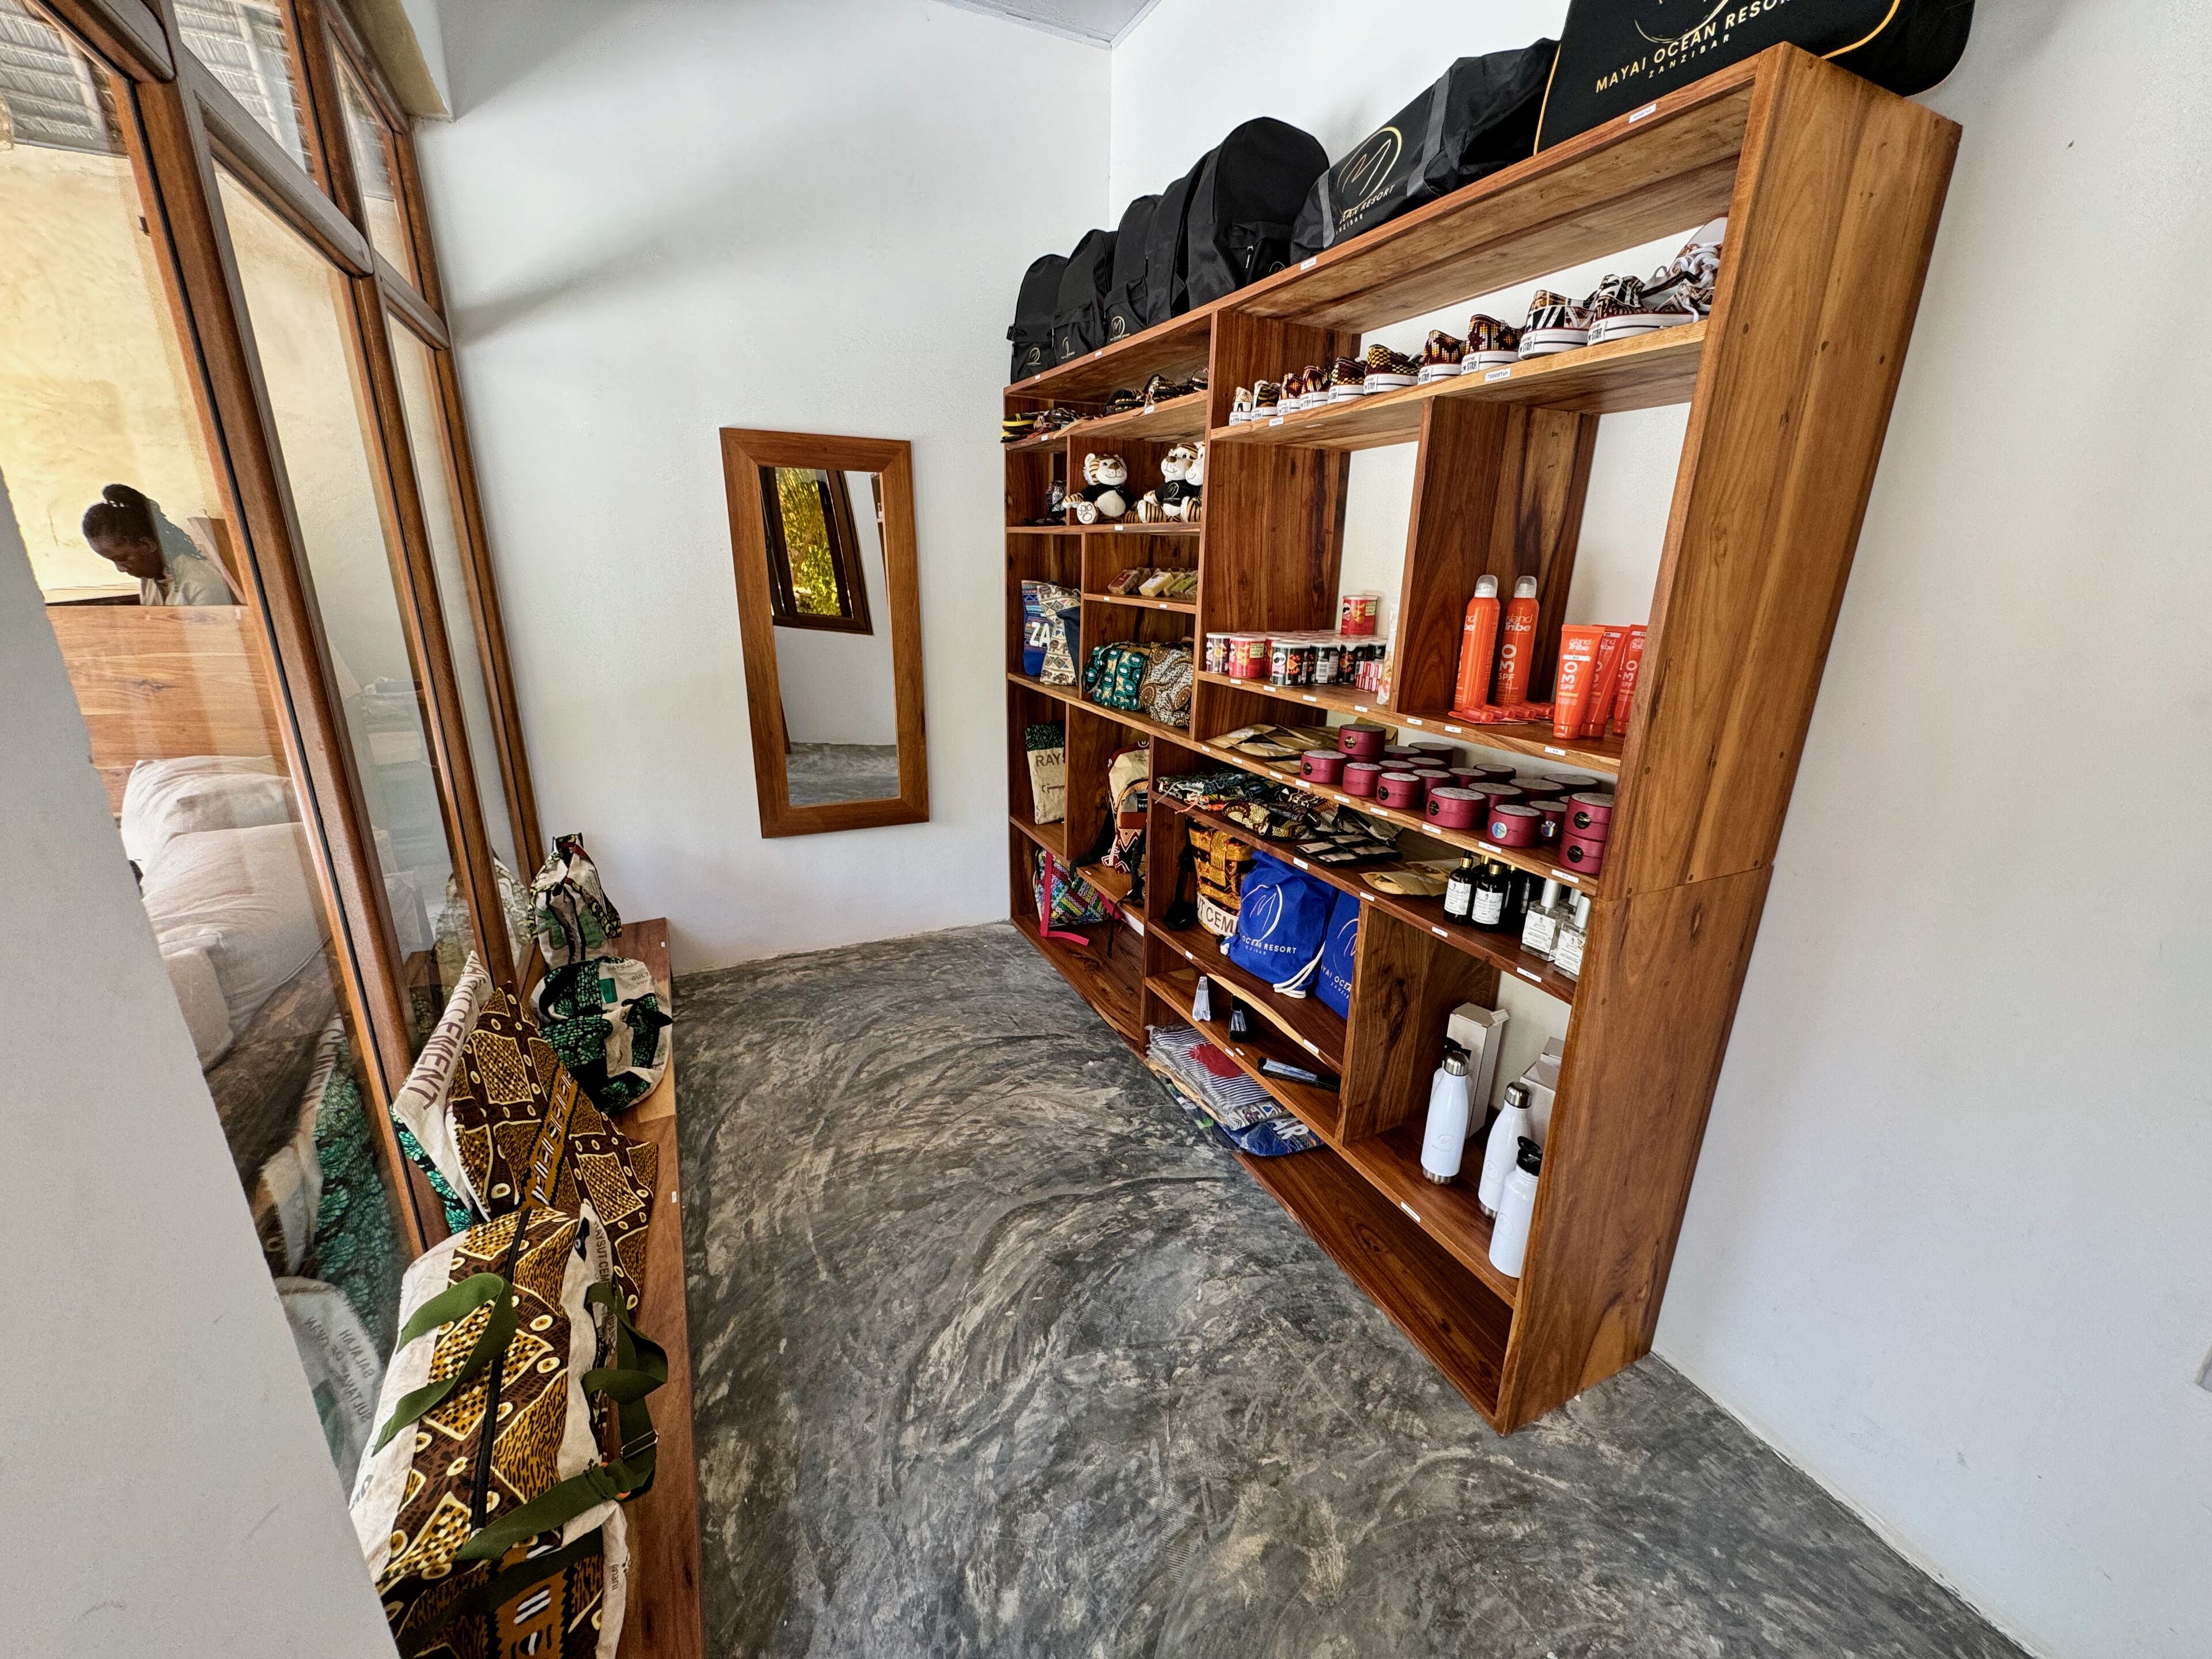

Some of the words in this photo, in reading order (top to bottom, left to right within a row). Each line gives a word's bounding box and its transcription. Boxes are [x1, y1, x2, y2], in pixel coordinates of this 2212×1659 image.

[1596, 57, 1646, 93] MAYAI
[1654, 22, 1717, 63] OCEAN
[1725, 0, 1790, 29] RESO
[1648, 34, 1730, 78] ZANZIBAR
[1361, 184, 1396, 211] RESORT
[1592, 327, 1603, 340] STAR
[1523, 341, 1533, 352] STAR
[1467, 361, 1477, 370] STAR
[1505, 622, 1531, 632] Tribe
[1029, 622, 1051, 647] ZA
[1498, 673, 1515, 681] SPF
[1035, 753, 1065, 767] RAY
[1206, 907, 1234, 933] CEM
[1264, 944, 1297, 954] RESORT
[407, 1009, 465, 1111] CEMENT
